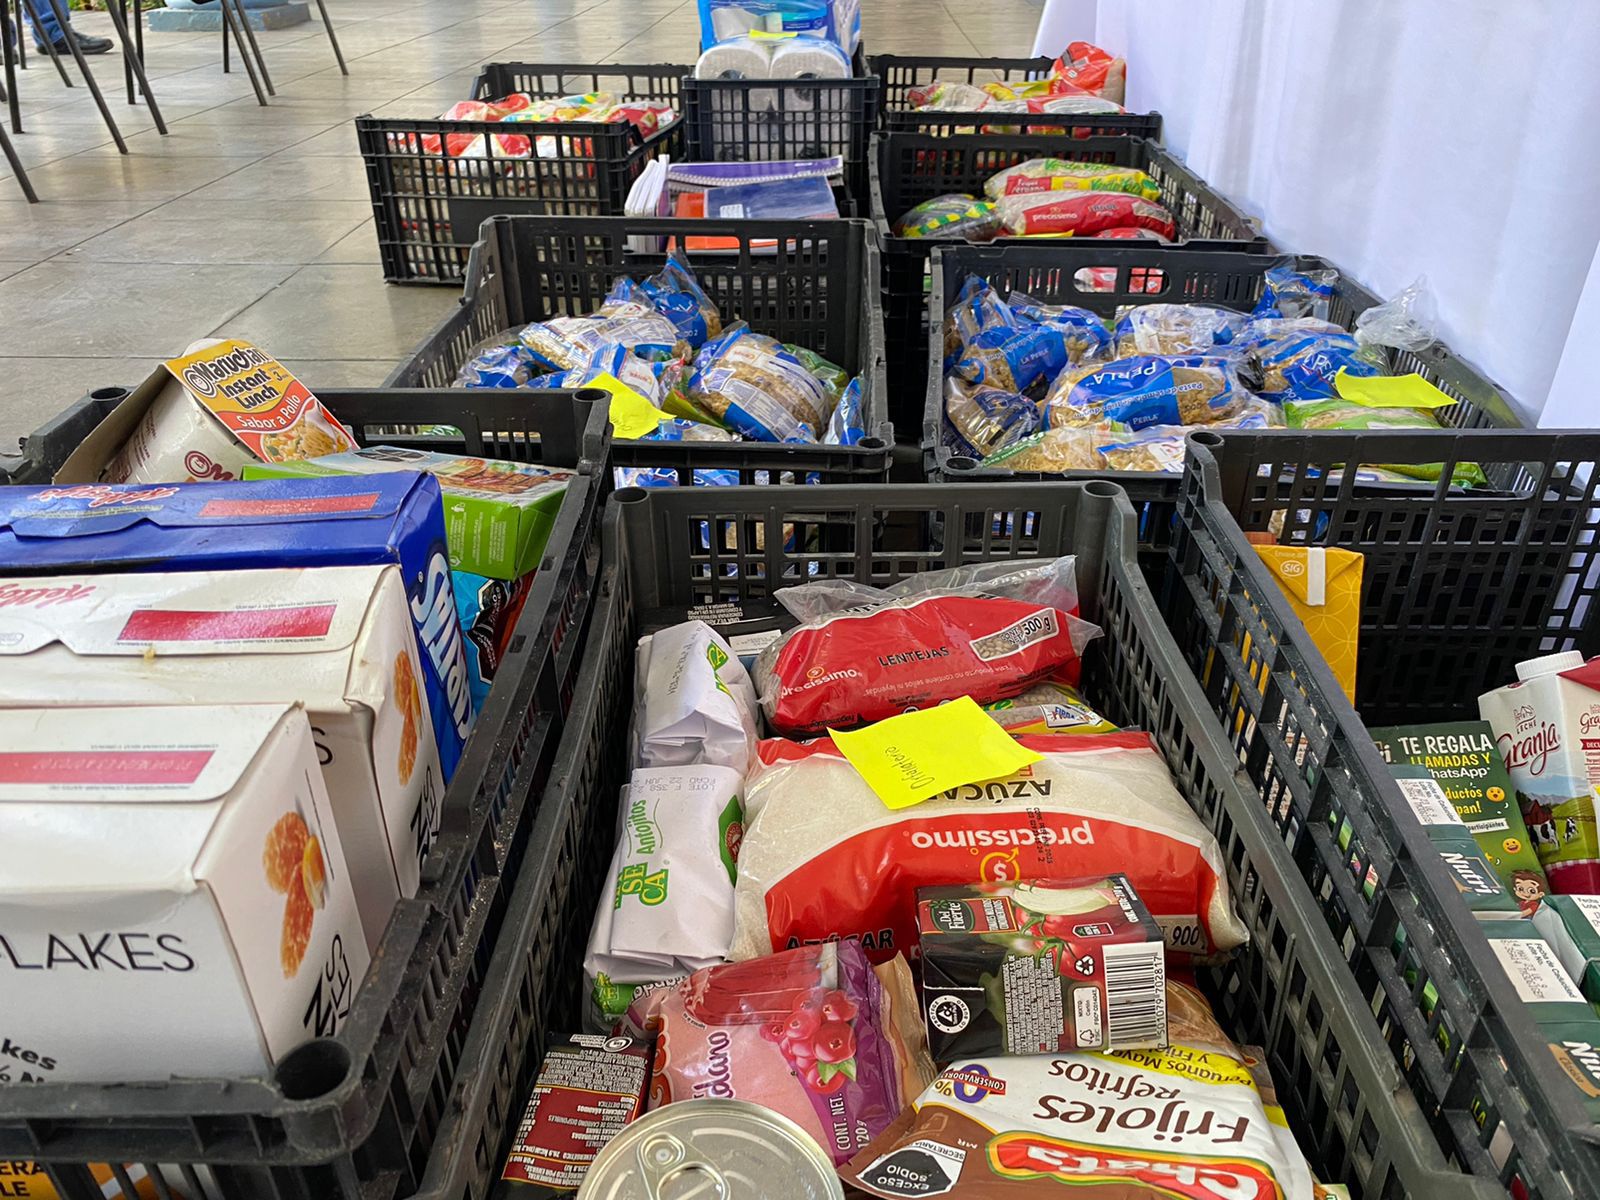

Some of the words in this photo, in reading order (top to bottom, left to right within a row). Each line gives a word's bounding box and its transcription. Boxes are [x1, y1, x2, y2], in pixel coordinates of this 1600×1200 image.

[193, 346, 272, 384] Maruchan
[1092, 362, 1157, 385] PERLA
[217, 367, 272, 398] Instant
[1179, 381, 1203, 393] Pasta
[235, 385, 280, 409] Lunch
[281, 394, 301, 419] Pollo
[238, 415, 276, 430] Sabor
[277, 415, 287, 425] a
[1132, 414, 1160, 425] PERLA
[1284, 563, 1300, 573] SIG
[1022, 617, 1043, 636] 500
[1043, 614, 1052, 631] g
[878, 645, 950, 667] LENTEJAS
[1516, 721, 1538, 735] LECHE
[1398, 736, 1421, 755] TE
[1424, 734, 1494, 755] REGALA
[1481, 752, 1491, 765] Y
[927, 778, 1051, 804] AZÚCA
[628, 799, 656, 855] Antojitos
[911, 820, 1094, 849] precissimo
[1440, 852, 1500, 897] Nutri
[940, 910, 951, 924] Del
[949, 900, 967, 930] Fuerte
[1172, 925, 1200, 946] 900
[1535, 942, 1549, 961] Fecha
[1550, 967, 1579, 1000] Caducidad
[1, 1037, 58, 1071] kes
[1197, 1053, 1210, 1063] y
[1048, 1058, 1181, 1101] Refritos
[1166, 1060, 1252, 1086] Peruanos
[829, 1091, 845, 1116] NET.
[1033, 1094, 1250, 1143] Frijoles
[833, 1115, 852, 1152] CONT.
[956, 1138, 978, 1150] MR
[876, 1174, 930, 1191] EXCESO
[886, 1164, 928, 1182] SODIO
